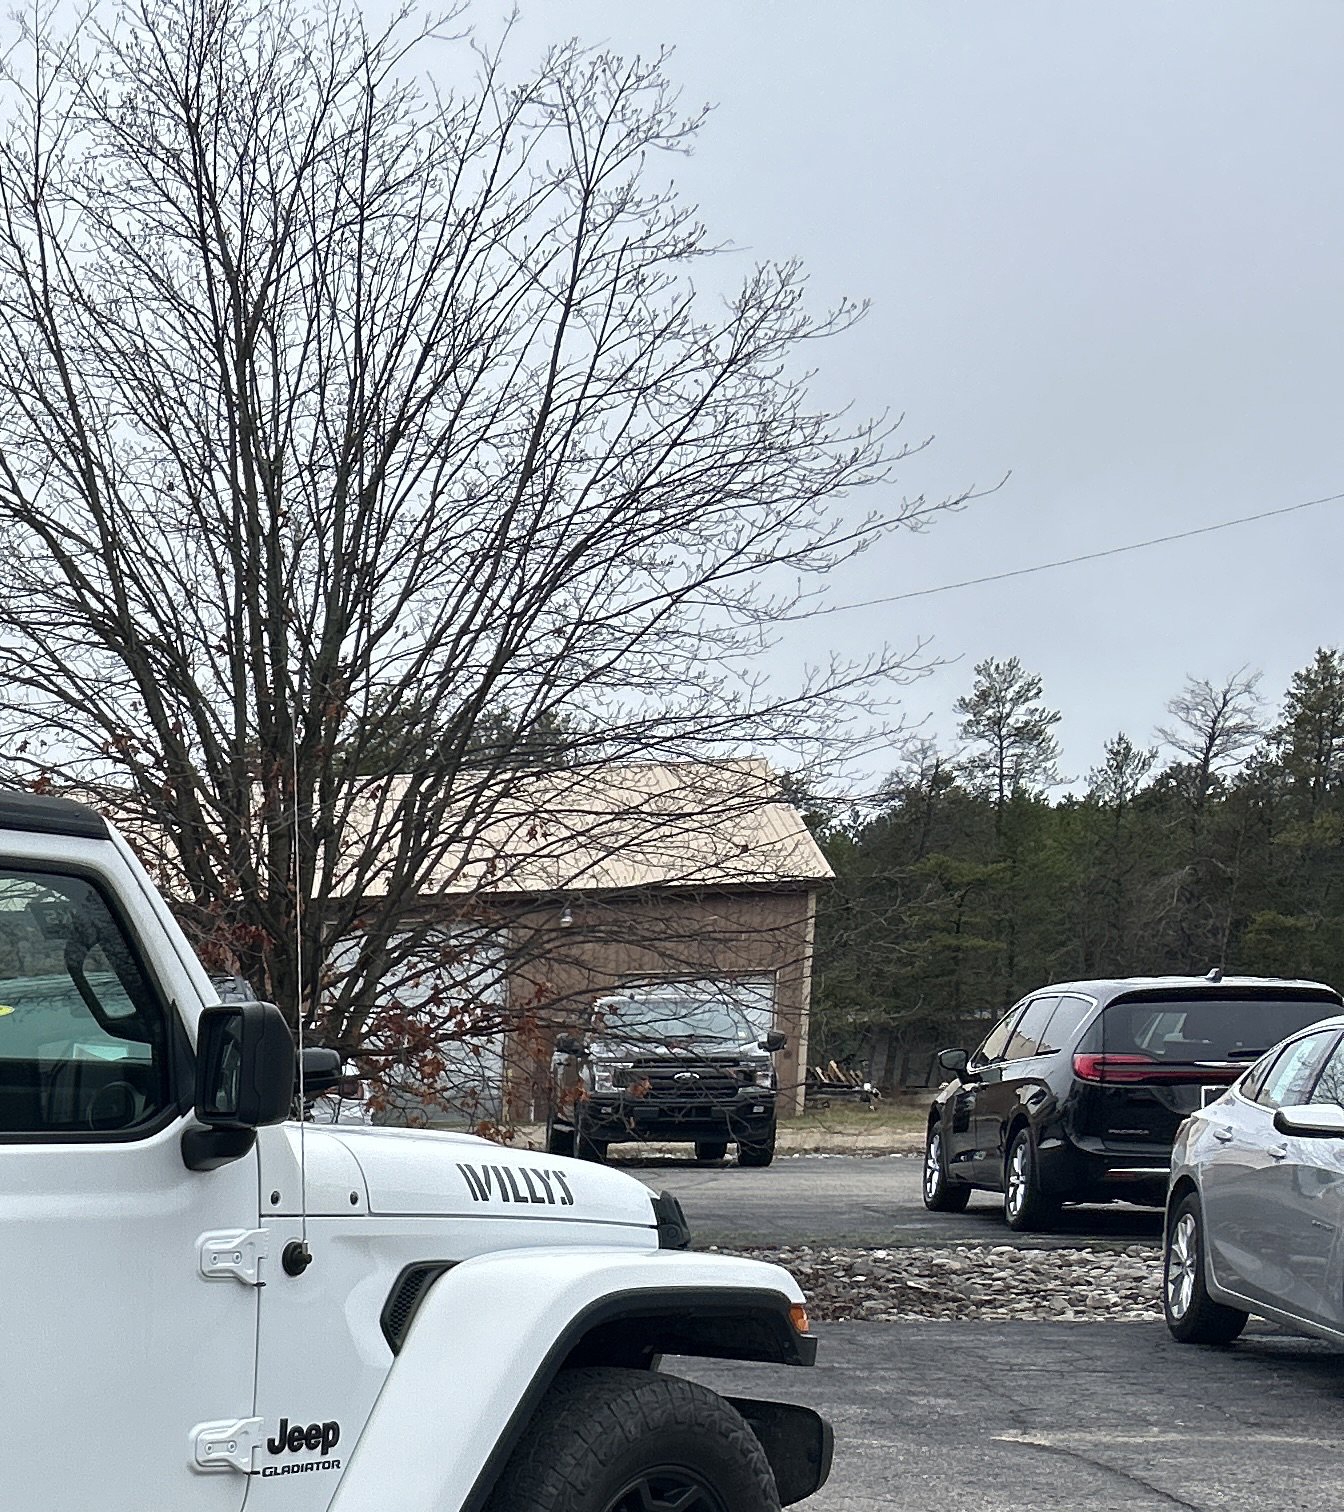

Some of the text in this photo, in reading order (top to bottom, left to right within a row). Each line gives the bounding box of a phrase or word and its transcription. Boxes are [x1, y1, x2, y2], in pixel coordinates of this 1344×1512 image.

[456, 1163, 574, 1205] WILLYS
[267, 1418, 340, 1456] Jeep
[262, 1460, 341, 1477] GLADIATOR
